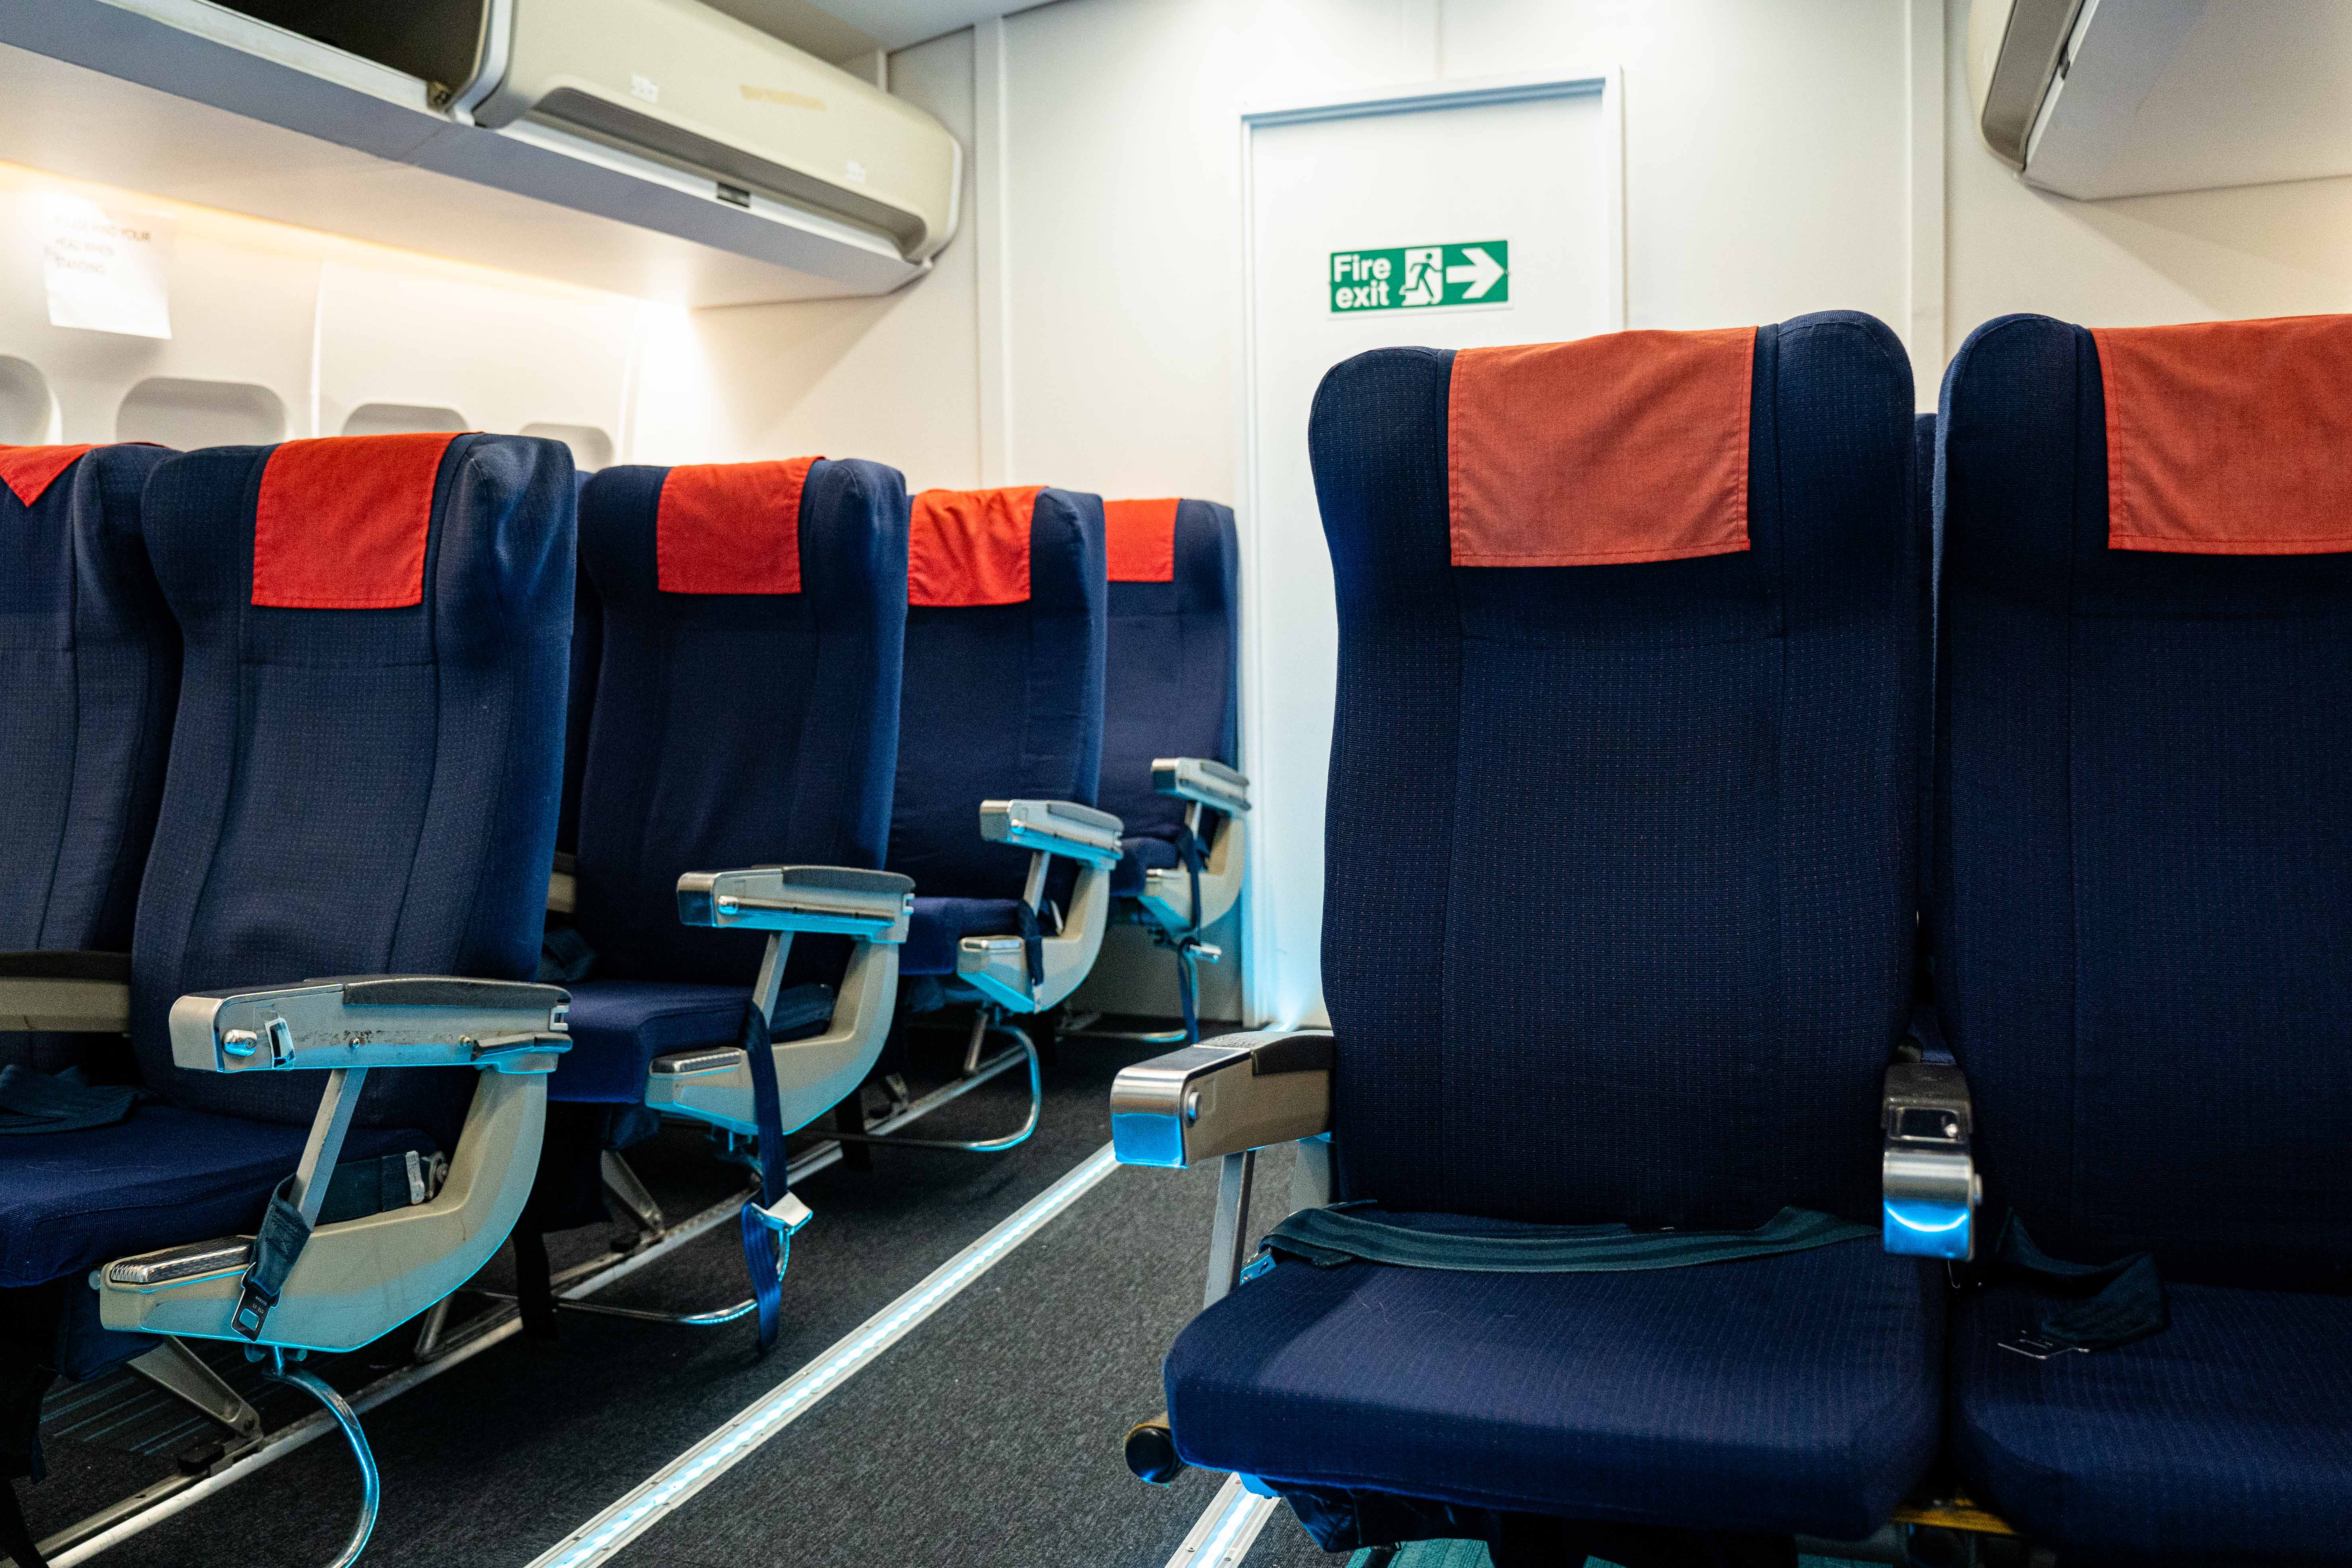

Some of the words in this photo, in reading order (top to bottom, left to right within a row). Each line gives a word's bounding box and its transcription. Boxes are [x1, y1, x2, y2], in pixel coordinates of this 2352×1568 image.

[121, 227, 151, 242] YOUR
[1334, 254, 1391, 282] Fire
[1336, 279, 1390, 308] exit
